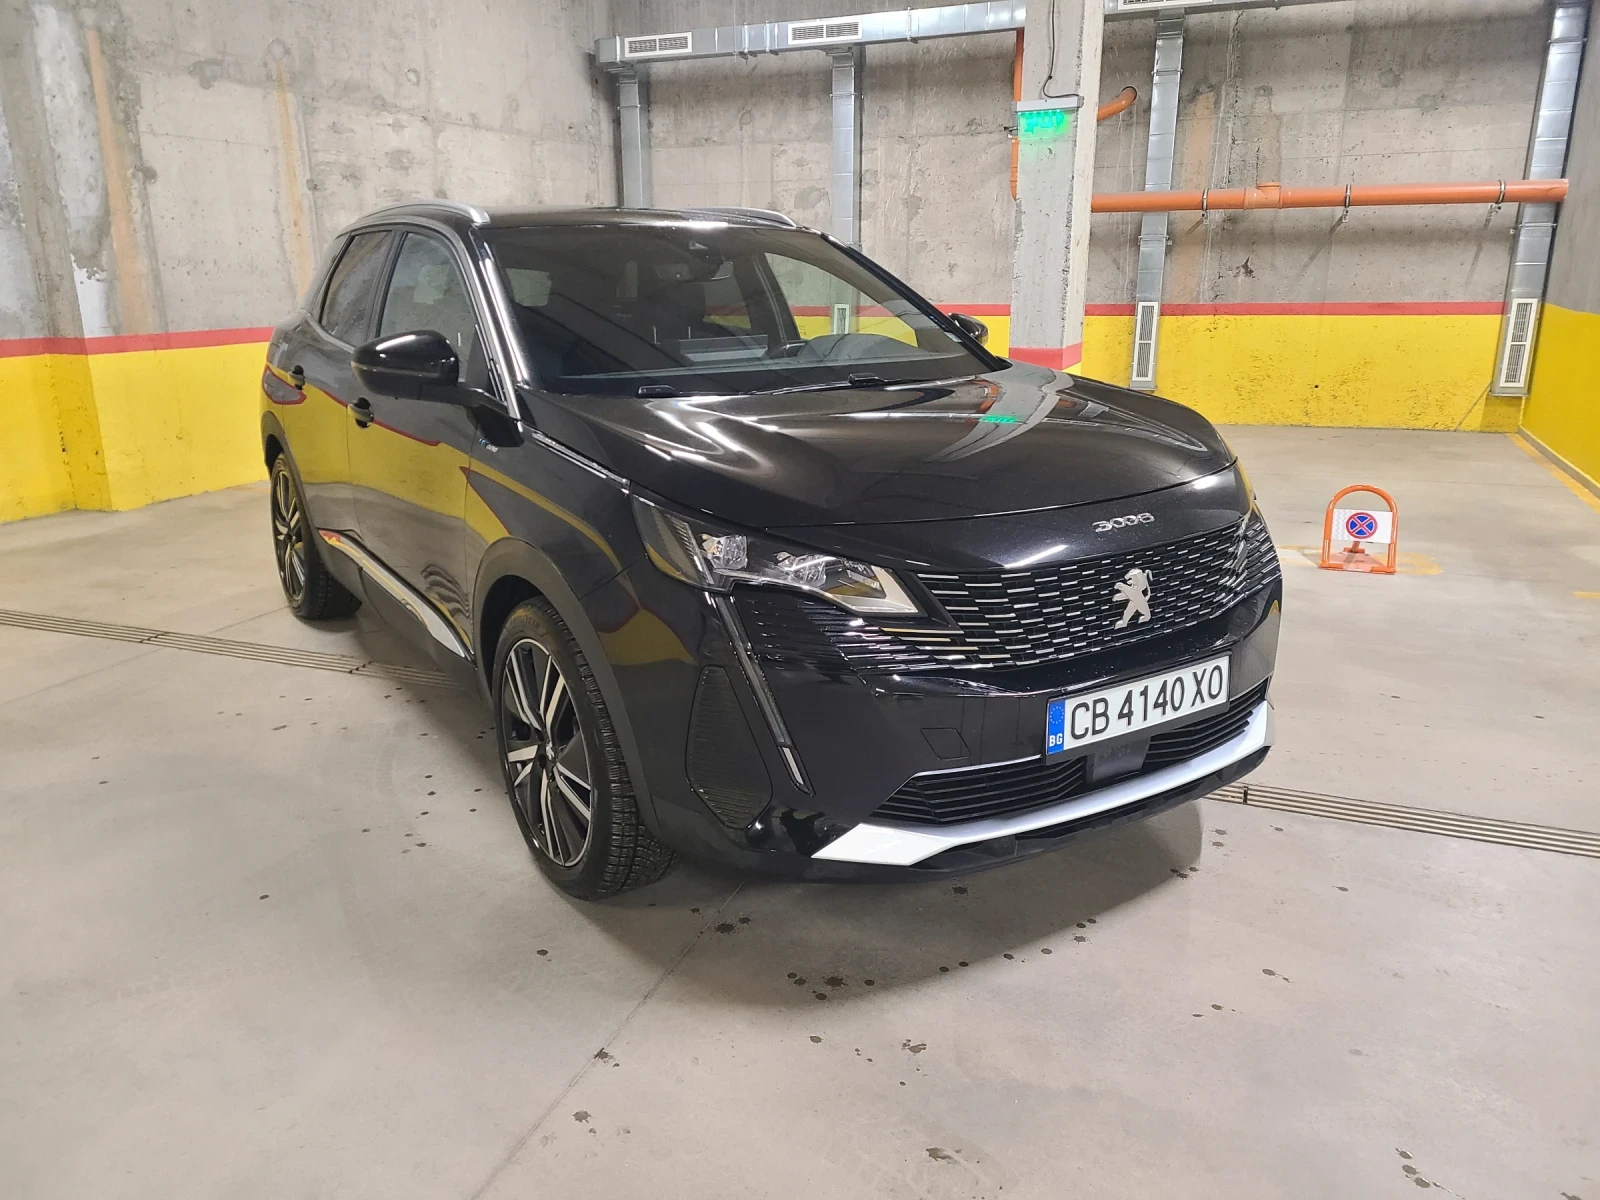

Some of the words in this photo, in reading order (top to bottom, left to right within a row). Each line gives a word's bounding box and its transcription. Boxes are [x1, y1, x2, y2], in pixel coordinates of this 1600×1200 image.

[1092, 512, 1155, 532] 3008
[1070, 697, 1110, 740] CB
[1117, 676, 1185, 727] 4140
[1190, 664, 1223, 707] XO
[1049, 732, 1063, 747] BG
